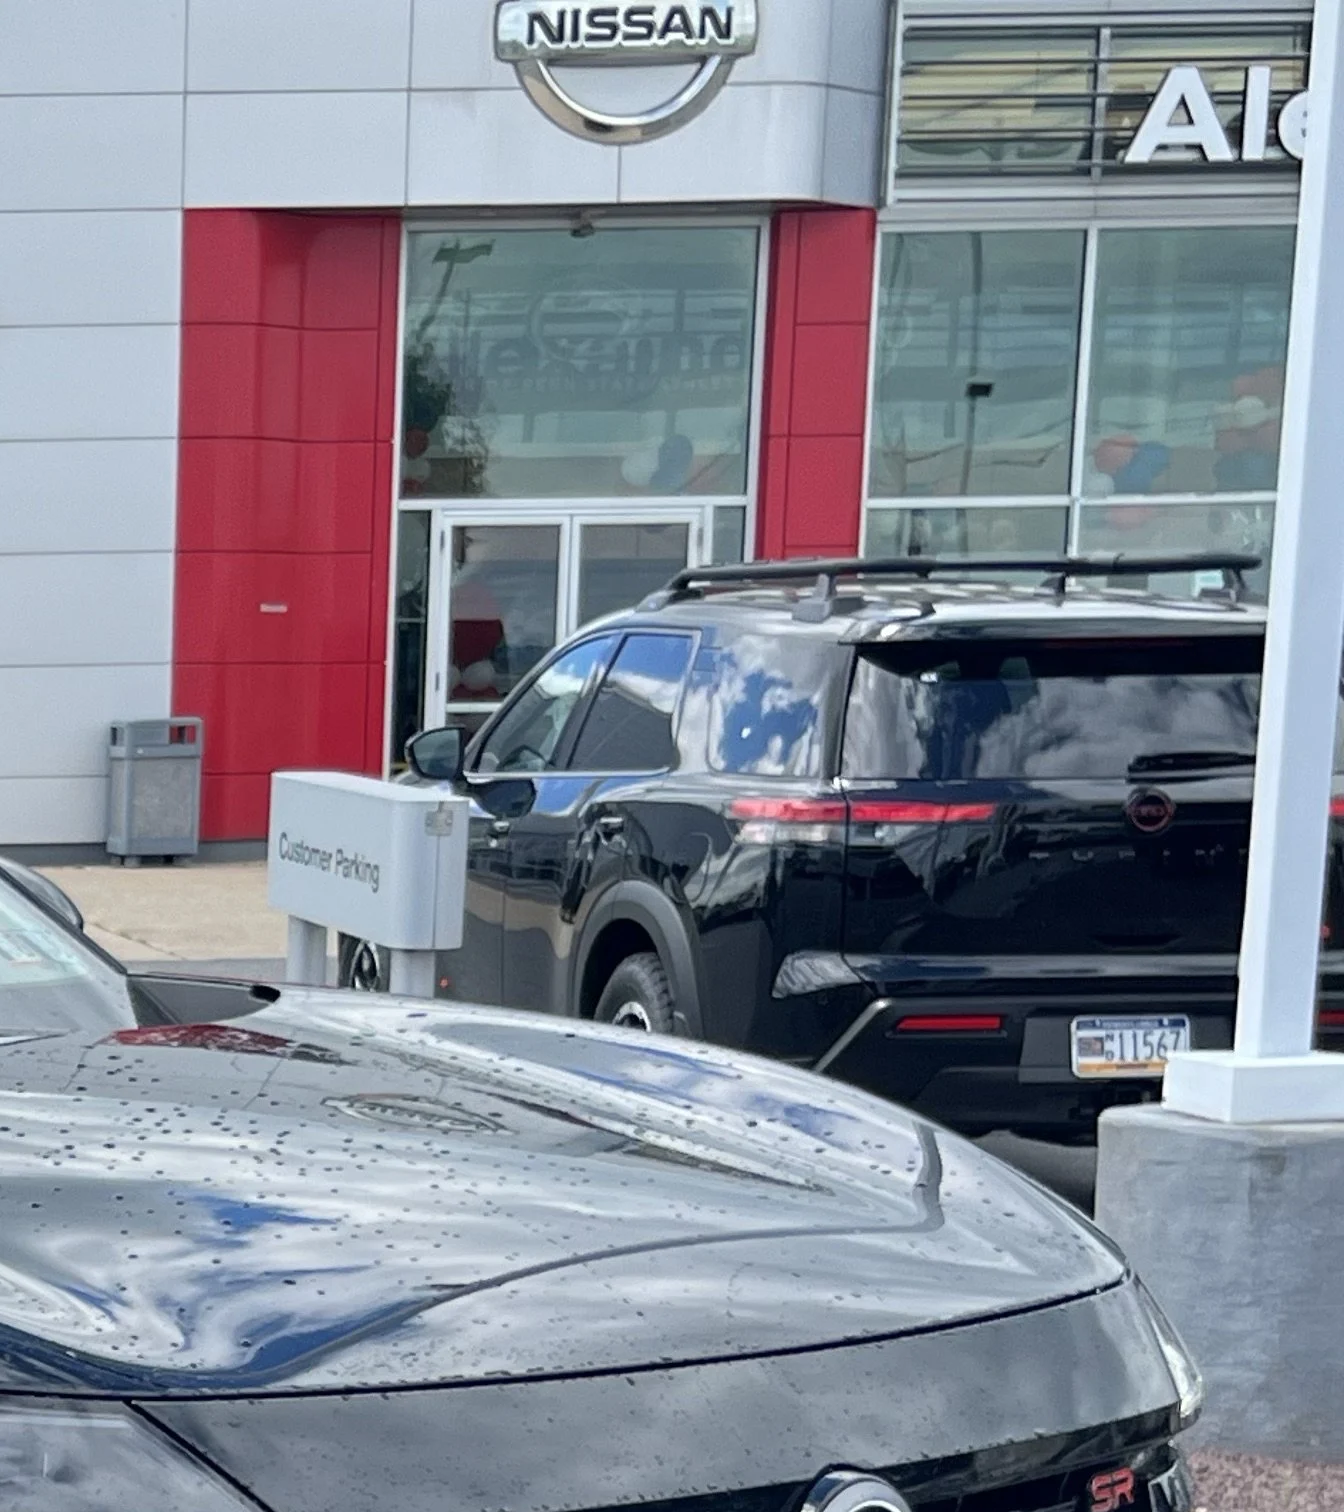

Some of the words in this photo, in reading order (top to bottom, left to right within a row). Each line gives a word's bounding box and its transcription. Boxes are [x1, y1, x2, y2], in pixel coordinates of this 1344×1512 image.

[525, 5, 736, 48] NISSAN
[278, 831, 333, 873] Customer
[335, 848, 381, 894] Parking
